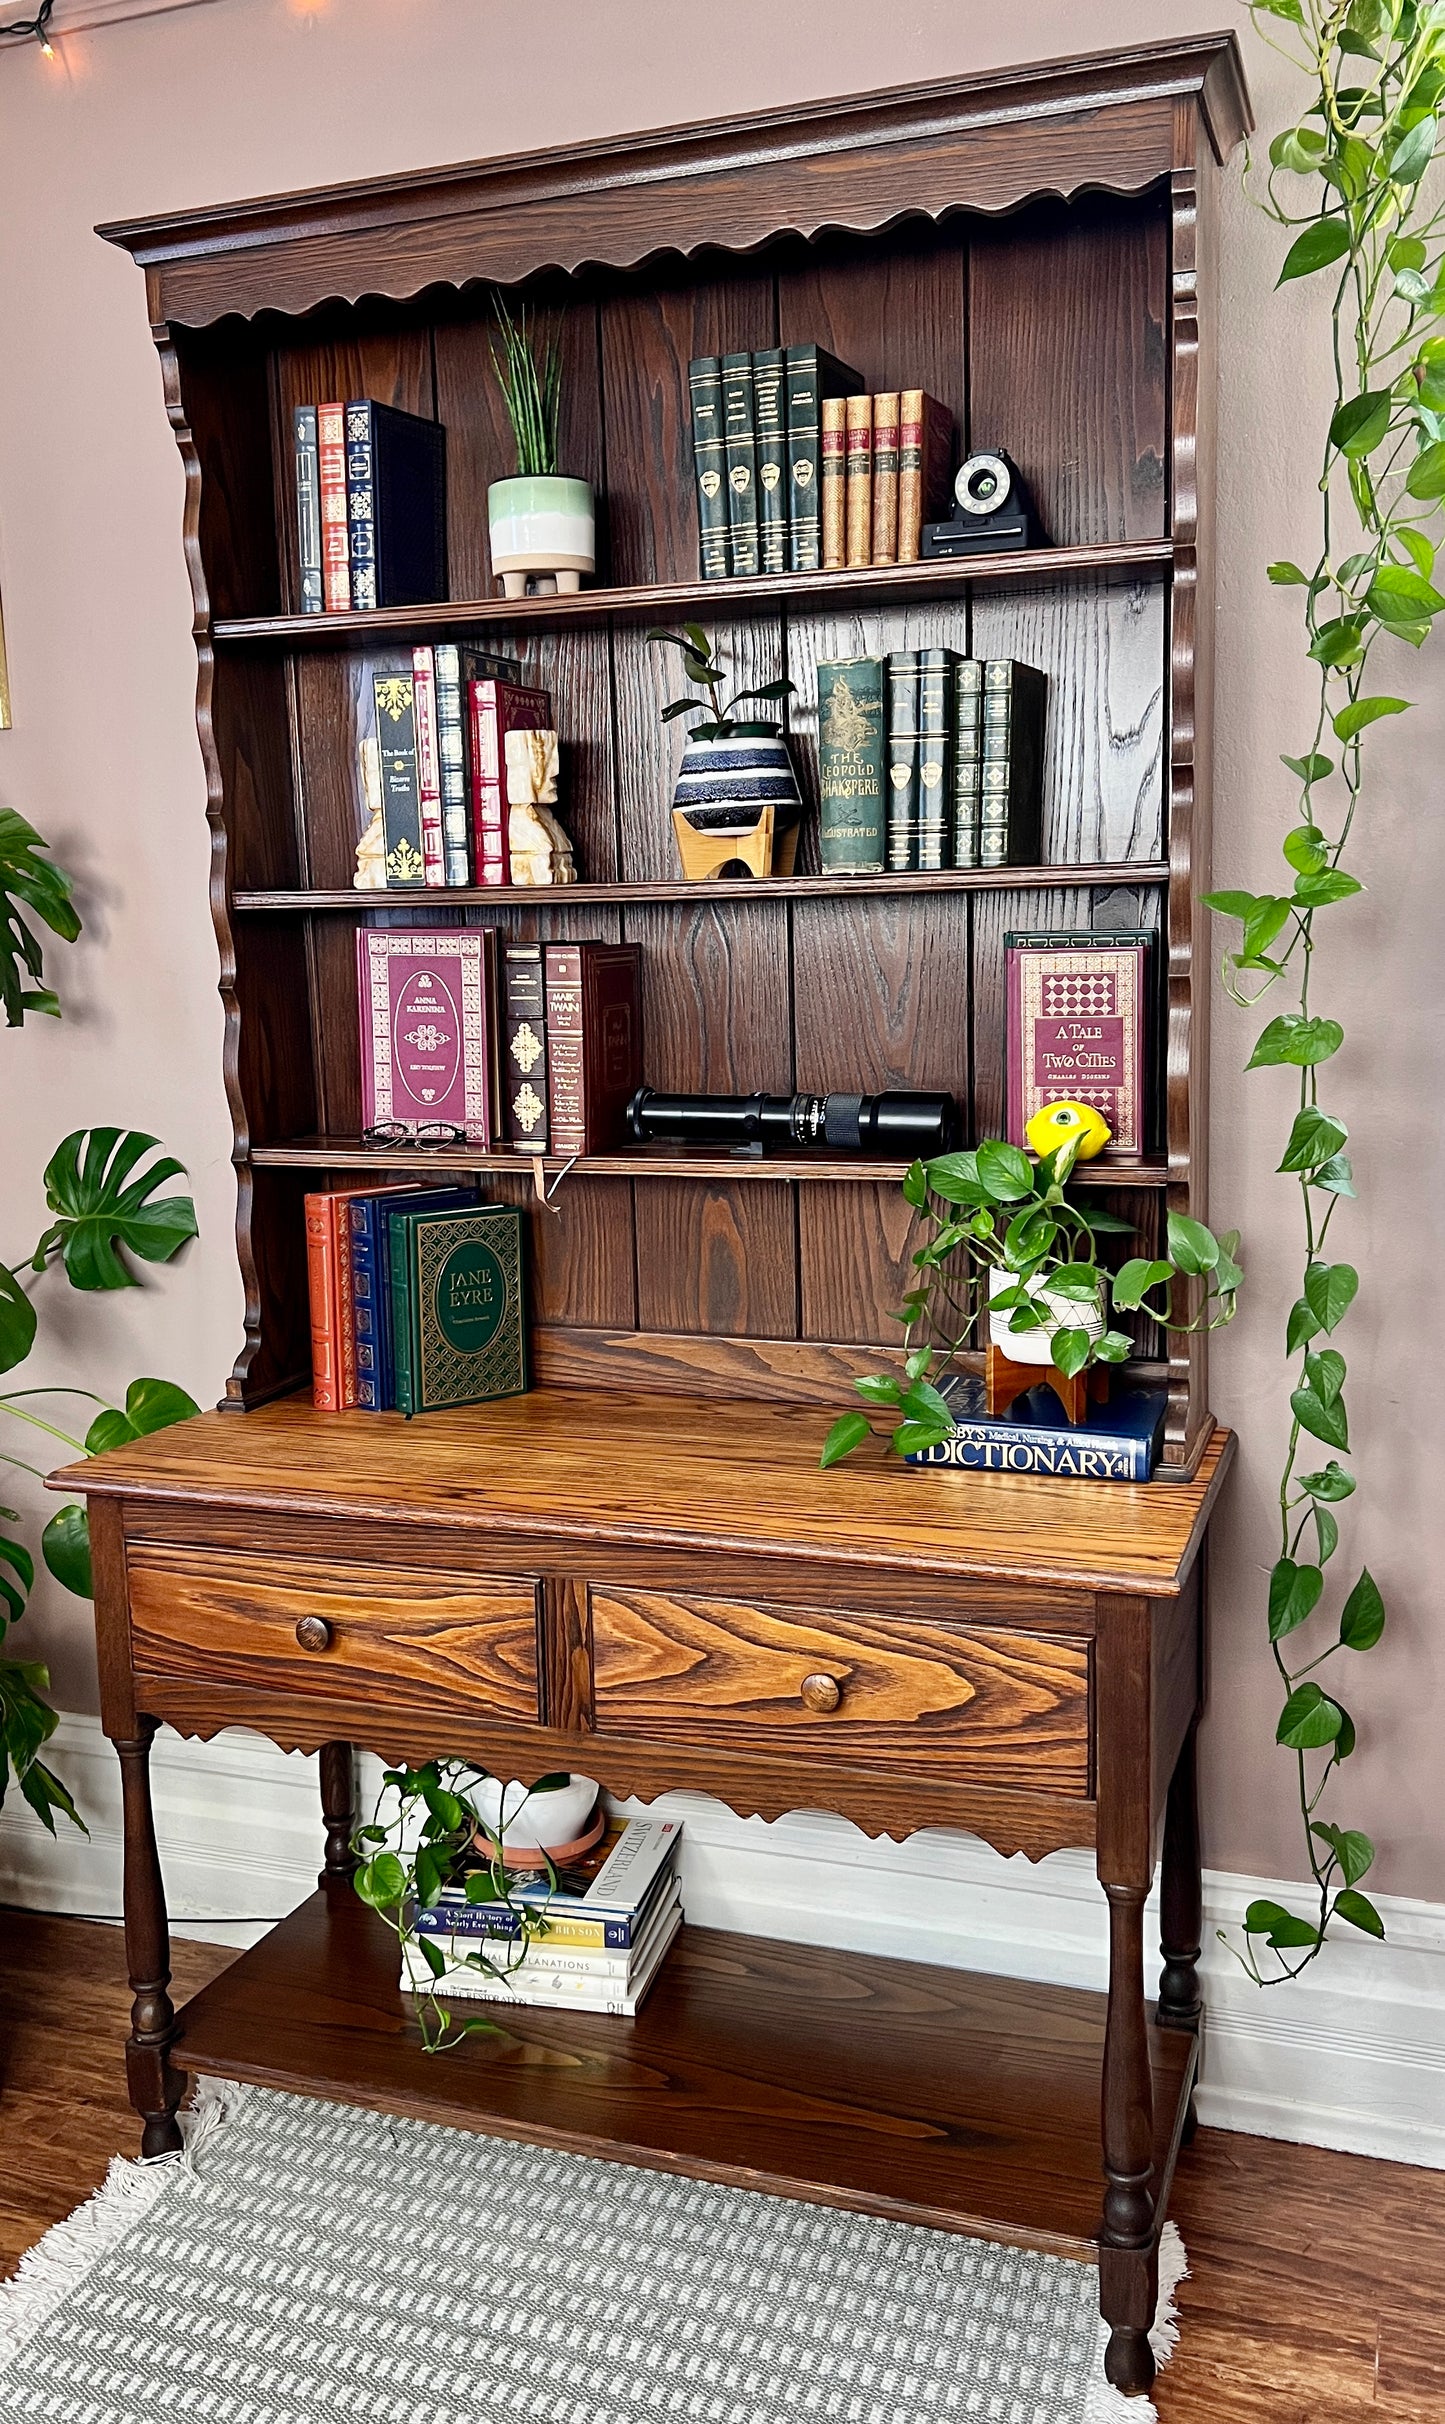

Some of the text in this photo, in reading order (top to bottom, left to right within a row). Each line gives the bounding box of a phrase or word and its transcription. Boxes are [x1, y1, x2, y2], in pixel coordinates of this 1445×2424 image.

[831, 754, 864, 764] THE
[822, 764, 874, 779] LEOPOLD
[821, 778, 879, 800] SHAKSPERE
[552, 993, 575, 1001] MARK
[550, 1002, 580, 1012] TWAIN
[1055, 1026, 1068, 1039] A
[449, 1269, 492, 1291] JANE
[450, 1288, 493, 1307] EYRE
[1057, 1438, 1065, 1446] &
[926, 1439, 1122, 1477] DICTIONARY
[597, 1821, 652, 1896] SWITZERLAND
[476, 1912, 502, 1922] Hitory
[472, 1921, 513, 1932] Everthing
[555, 1925, 600, 1937] BRYSON
